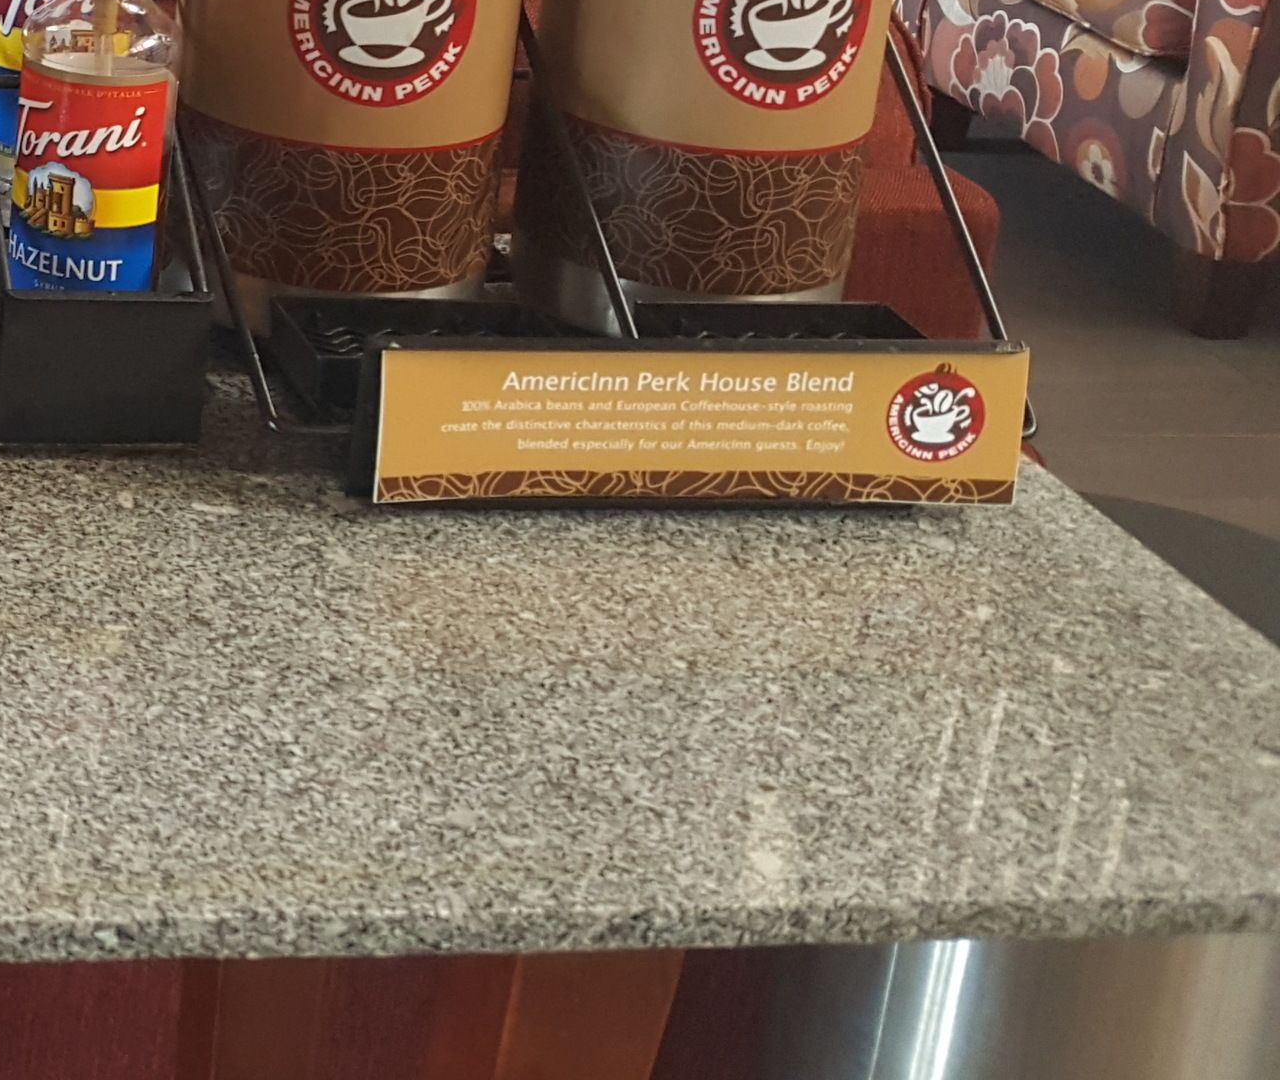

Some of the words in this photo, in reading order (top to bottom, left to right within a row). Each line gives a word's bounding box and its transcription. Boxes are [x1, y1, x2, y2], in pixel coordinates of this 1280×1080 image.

[394, 41, 463, 101] PERK
[797, 43, 859, 104] PERK
[17, 96, 144, 163] Torani
[8, 229, 124, 282] HAZELNUT
[493, 399, 542, 412] Arabica
[545, 399, 583, 412] beans
[587, 399, 613, 412] and
[616, 399, 677, 415] European
[800, 400, 854, 414] roasting
[501, 370, 630, 392] AmericInn
[636, 370, 691, 392] Perk
[699, 370, 778, 392] House
[785, 370, 856, 392] Blend
[439, 420, 478, 433] create
[481, 419, 502, 431] the
[505, 418, 572, 431] distinctive
[574, 418, 667, 432] characteristics
[671, 418, 687, 431] of
[688, 418, 713, 431] this
[715, 418, 804, 432] medium-dark
[806, 419, 850, 433] coffee,
[516, 437, 570, 450] blended
[571, 437, 636, 452] especially
[637, 437, 658, 450] for
[660, 440, 683, 450] our
[755, 439, 800, 453] guests.
[804, 438, 846, 453] Enjoy!
[889, 393, 933, 460] AMERICINN
[938, 432, 976, 459] PERK
